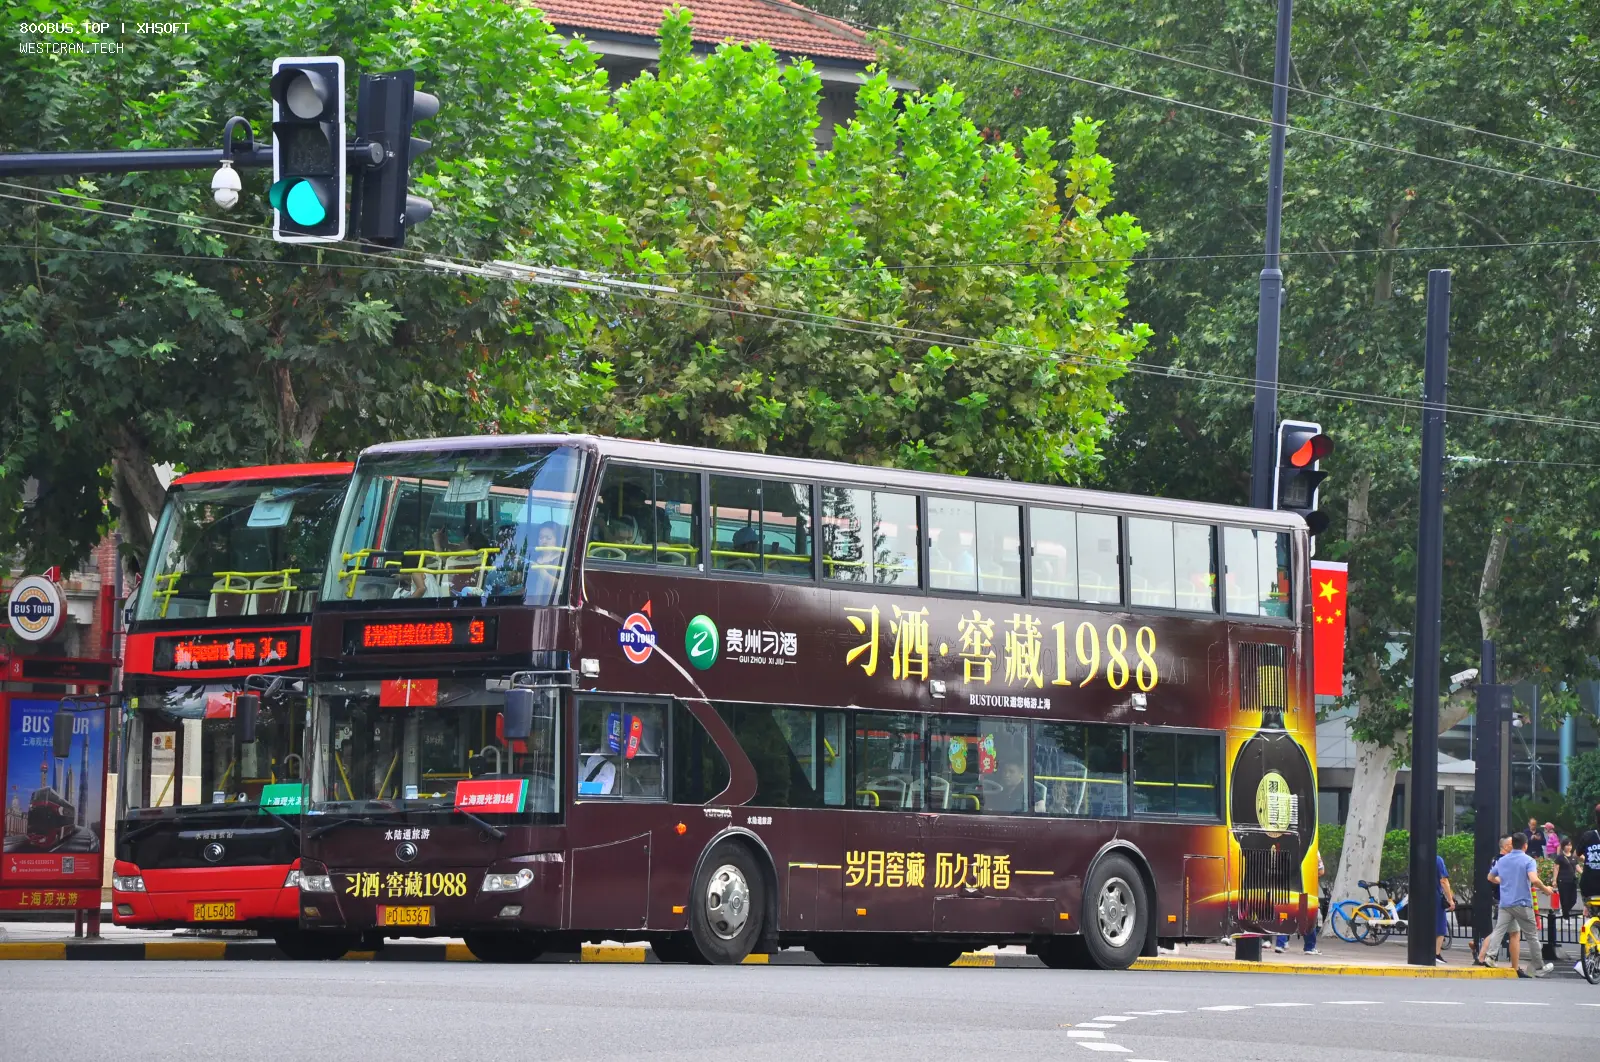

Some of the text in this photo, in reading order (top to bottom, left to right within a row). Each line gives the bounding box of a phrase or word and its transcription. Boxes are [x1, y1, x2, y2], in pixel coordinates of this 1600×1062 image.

[14, 604, 52, 614] BUS TOUR
[620, 632, 656, 646] BUS TOUR
[725, 628, 798, 656] 贵州习酒
[843, 603, 1159, 693] 习酒·窖藏1988
[13, 662, 20, 673] 3
[22, 715, 50, 734] BUS
[459, 792, 514, 806] 上海观光游1线
[384, 827, 431, 841] 水陆通旅游
[845, 849, 1011, 891] 岁月窖藏 历久弥香
[345, 871, 468, 899] 习酒·窖藏1988
[18, 891, 79, 906] 上海观光游
